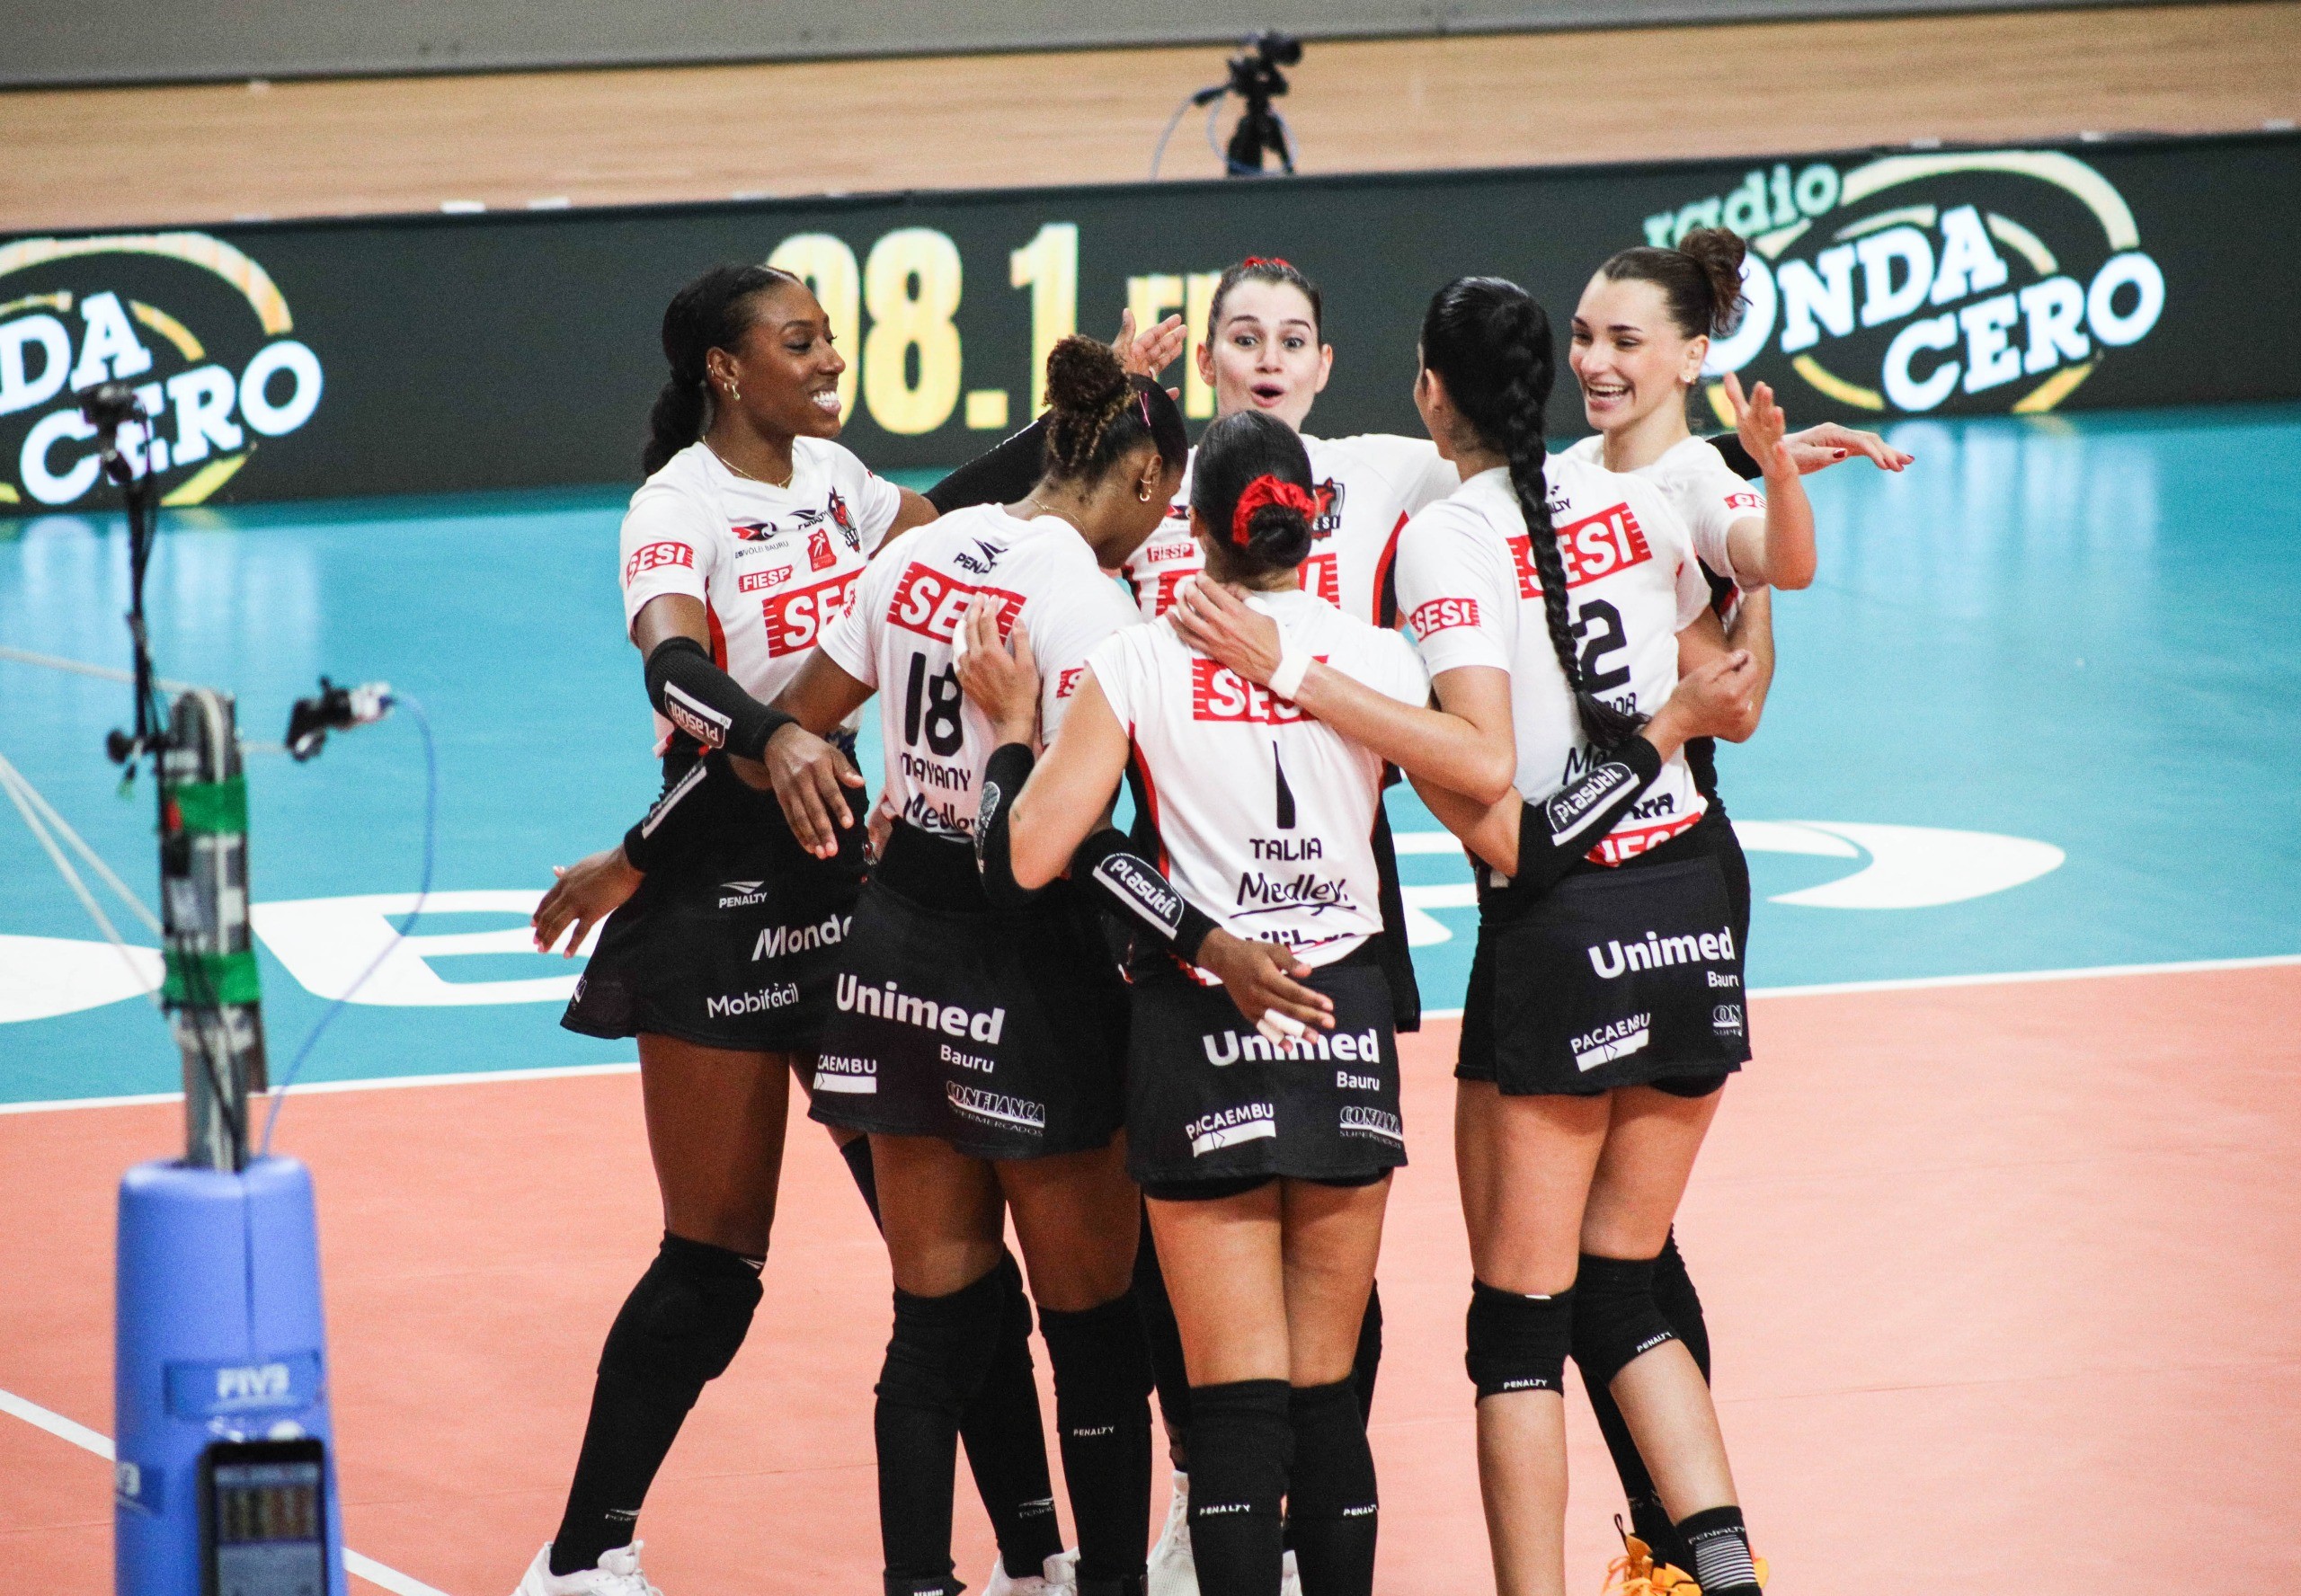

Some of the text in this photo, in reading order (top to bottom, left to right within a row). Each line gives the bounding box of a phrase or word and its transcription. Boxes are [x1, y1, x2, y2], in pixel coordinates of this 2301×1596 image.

[1882, 252, 2165, 412] CERO
[628, 544, 687, 581] SESI
[742, 568, 791, 590] FIESP
[784, 578, 857, 647] SE
[901, 576, 1008, 638] SE
[1414, 599, 1472, 639] SESI
[904, 652, 964, 757] 18
[1208, 668, 1302, 720] SE
[1248, 837, 1323, 861] TALIA
[719, 892, 768, 909] PENALTY
[1588, 926, 1736, 979] Unimed
[836, 972, 1006, 1044] Unimed
[940, 1044, 995, 1073] Bauru
[1337, 1070, 1381, 1091] Bauru
[1186, 1104, 1274, 1139] PACAEMBU
[1637, 1331, 1673, 1353] PENALTY
[1503, 1379, 1548, 1389] PENALTY
[1073, 1425, 1115, 1437] PENALTY
[1199, 1504, 1250, 1516] PENALTY
[1687, 1526, 1746, 1545] PENALTY
